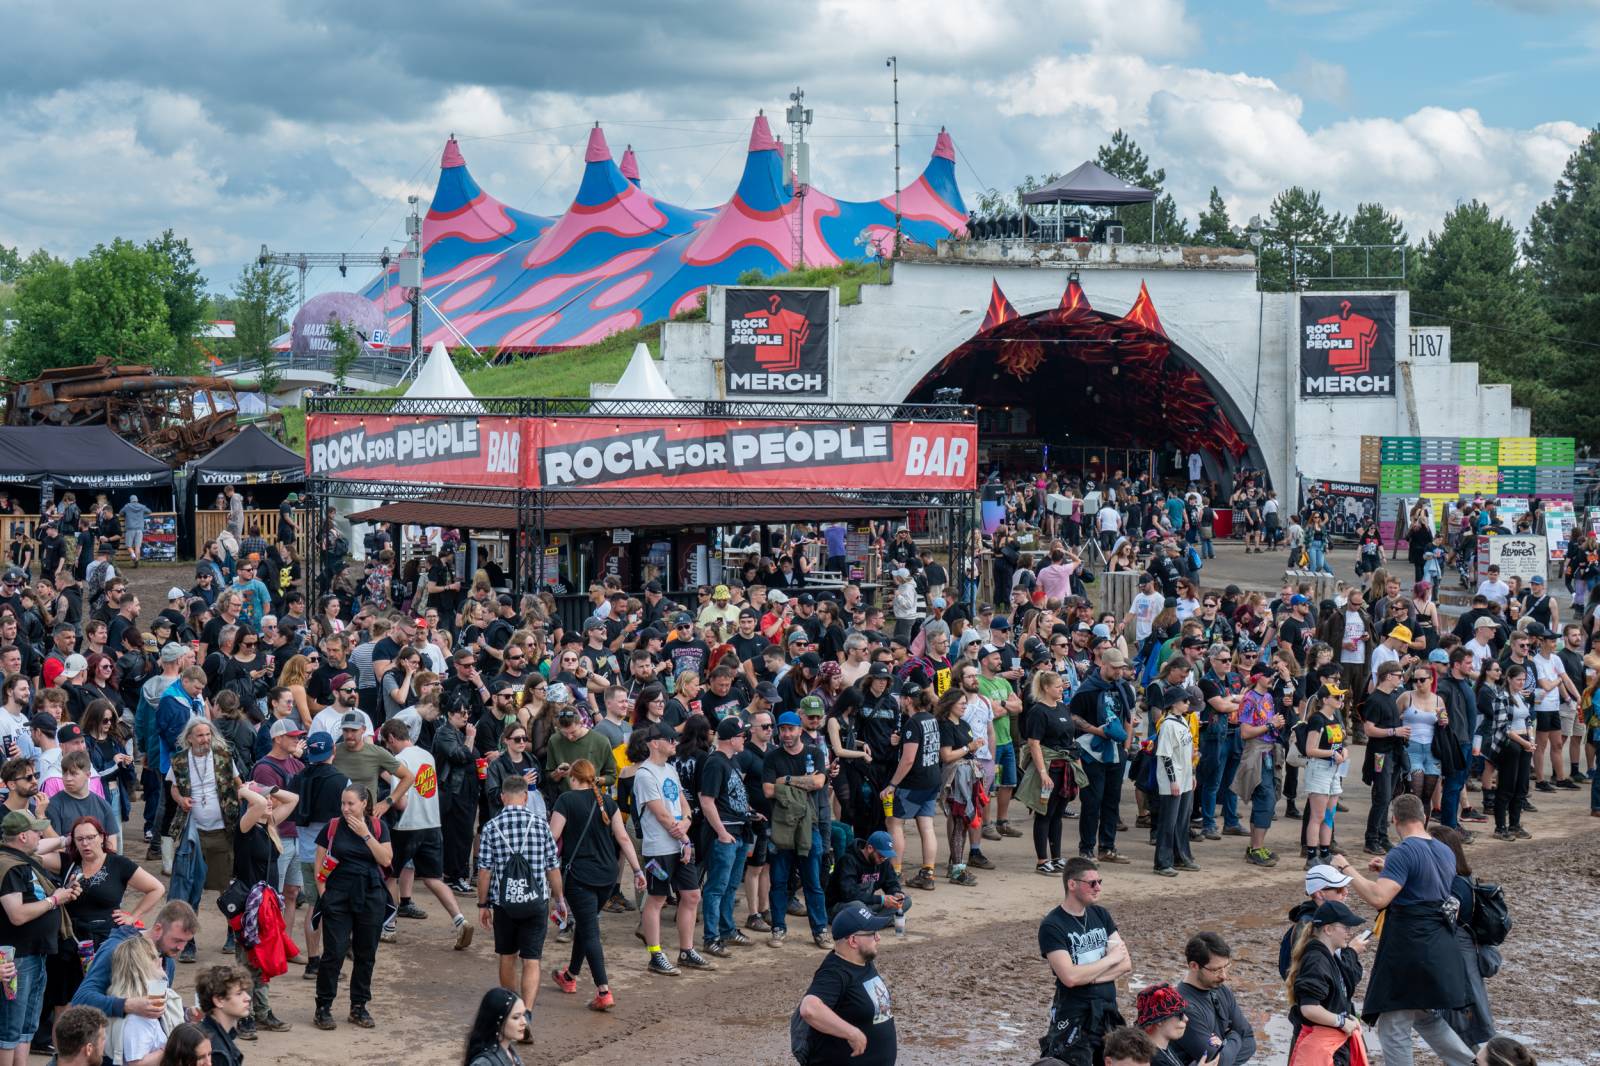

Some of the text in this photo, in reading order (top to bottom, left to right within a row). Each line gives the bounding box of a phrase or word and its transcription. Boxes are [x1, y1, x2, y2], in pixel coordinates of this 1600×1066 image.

[731, 318, 768, 329] ROCK
[1306, 323, 1340, 335] ROCK
[731, 335, 782, 345] PEOPLE
[1306, 339, 1353, 349] PEOPLE
[1408, 334, 1443, 357] H187
[730, 373, 822, 391] MERCH
[1306, 375, 1390, 392] MERCH
[312, 419, 521, 474] ROCK FOR PEOPLE BAR
[544, 426, 969, 486] ROCK FOR PEOPLE BAR
[202, 473, 242, 483] VÝKUP
[1330, 483, 1350, 492] SHOP
[1350, 485, 1375, 494] MERCH
[505, 890, 539, 904] PEOPLE
[506, 886, 525, 896] FOR
